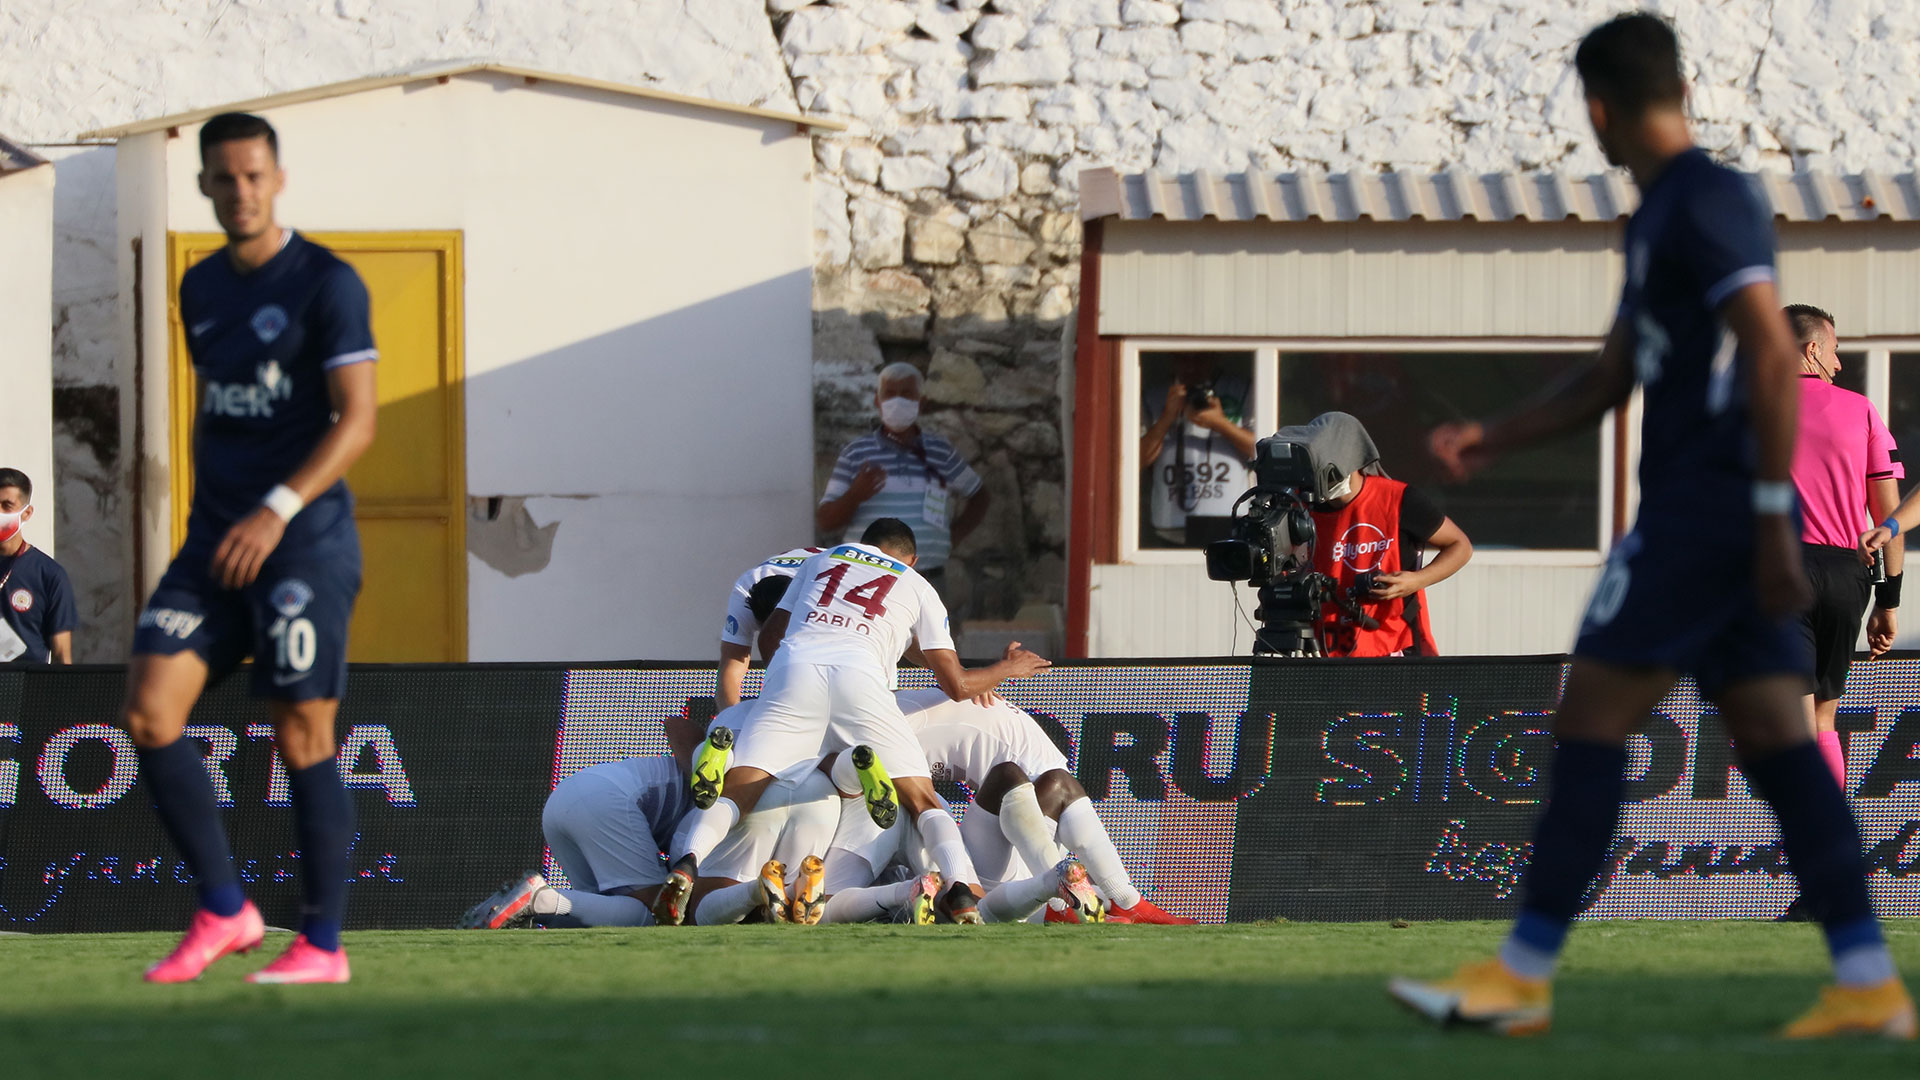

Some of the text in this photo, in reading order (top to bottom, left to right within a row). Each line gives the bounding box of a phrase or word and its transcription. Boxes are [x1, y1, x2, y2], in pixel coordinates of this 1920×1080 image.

[1163, 462, 1230, 486] 0592
[1167, 484, 1224, 501] PESS
[1332, 538, 1395, 562] Bilyoner
[814, 562, 899, 621] 14
[268, 616, 318, 672] 10
[0, 722, 418, 810] ORTA
